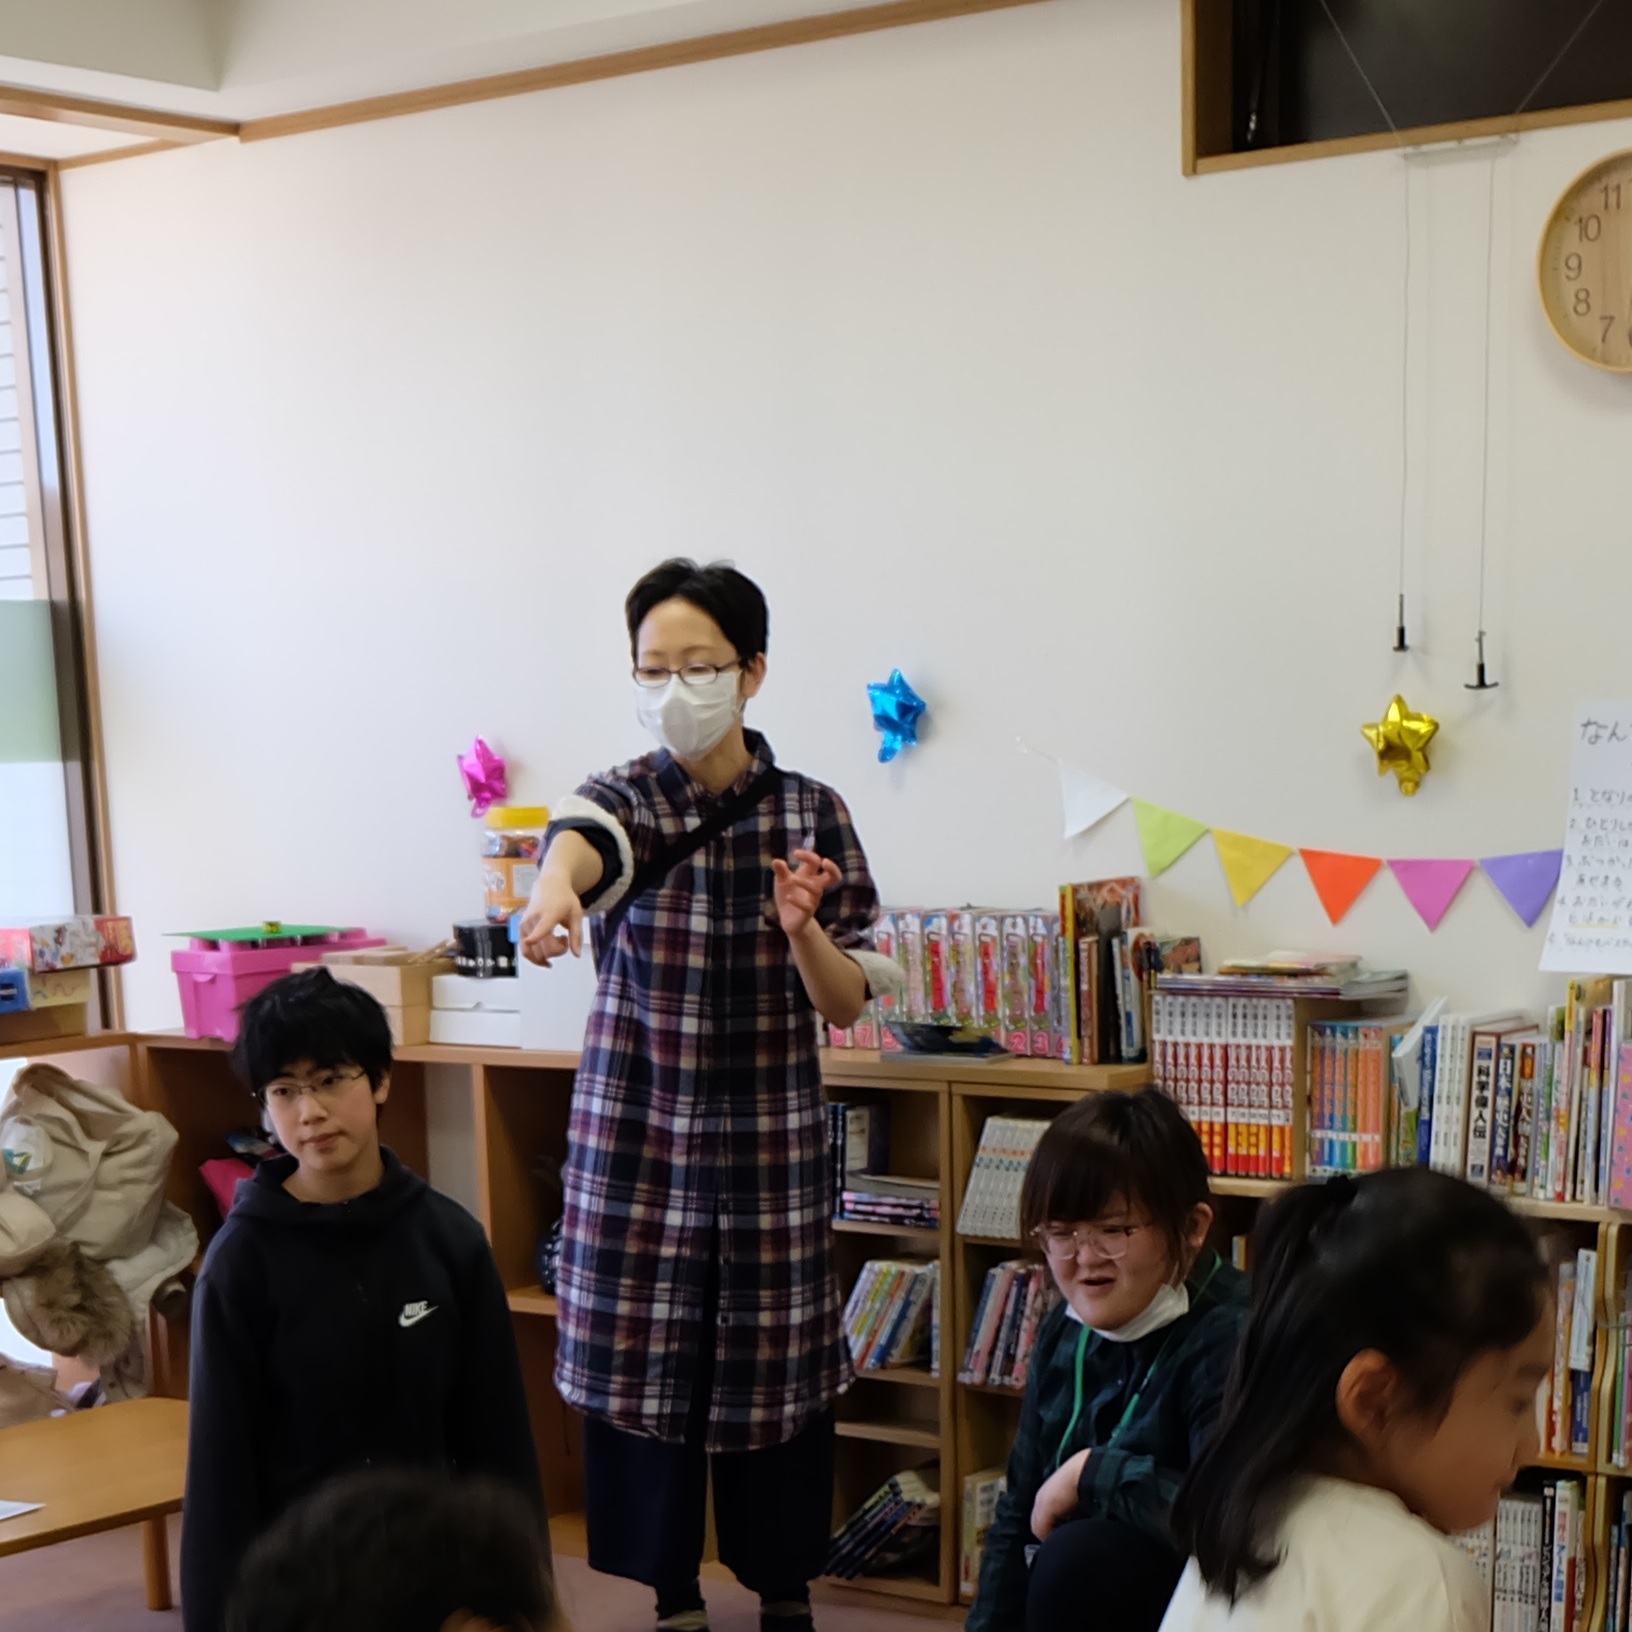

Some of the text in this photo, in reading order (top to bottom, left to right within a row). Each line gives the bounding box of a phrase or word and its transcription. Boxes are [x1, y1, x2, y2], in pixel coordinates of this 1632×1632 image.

[1601, 184, 1622, 210] 11
[1576, 214, 1601, 242] 10
[1564, 253, 1582, 281] 9
[1572, 288, 1591, 316] 8
[1599, 315, 1615, 343] 7
